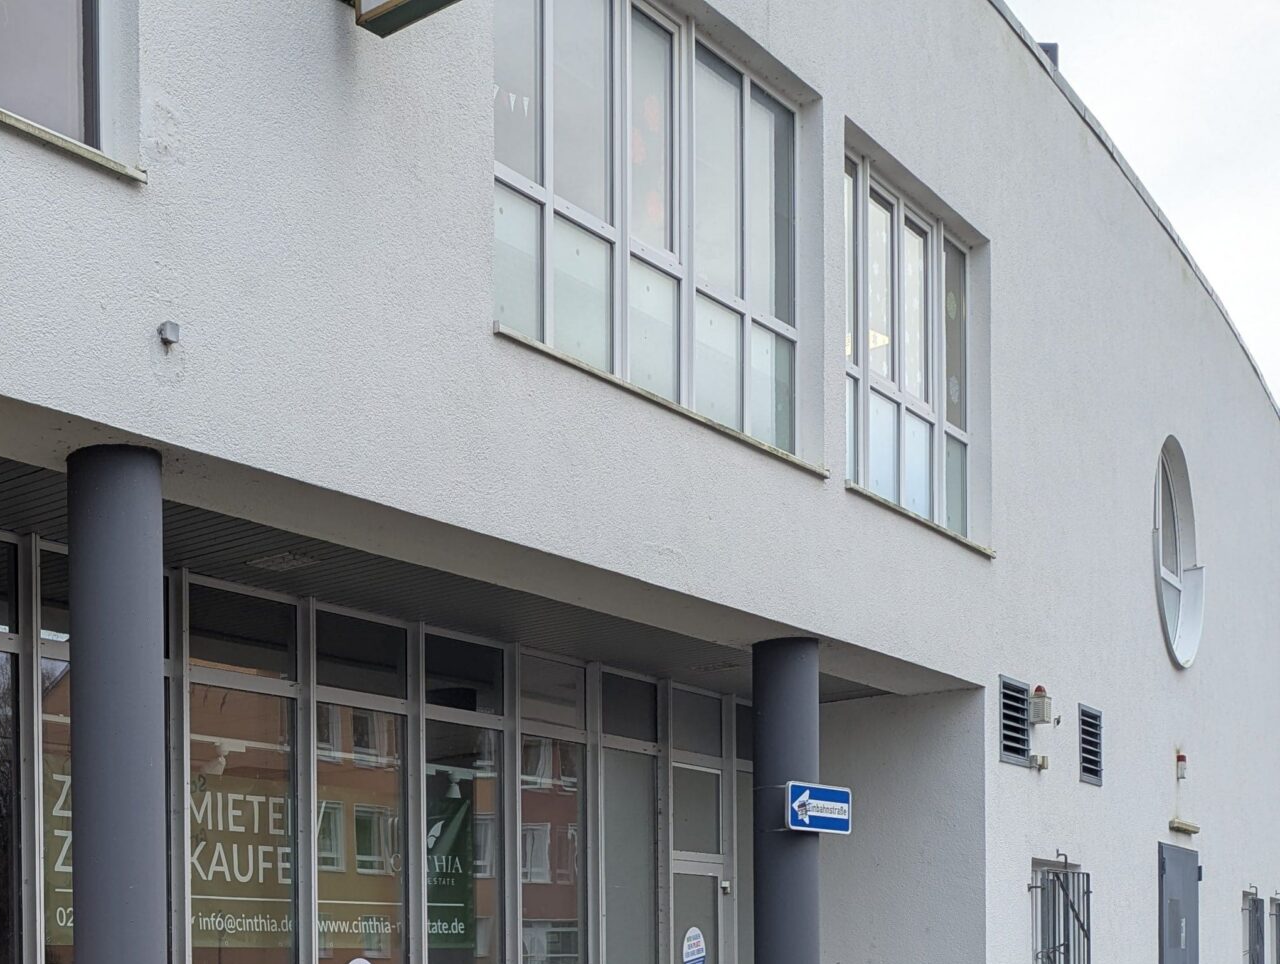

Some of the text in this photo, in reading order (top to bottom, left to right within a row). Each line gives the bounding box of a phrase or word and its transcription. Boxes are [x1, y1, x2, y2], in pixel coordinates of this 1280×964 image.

[52, 773, 72, 818] Z
[190, 791, 292, 836] MIETE
[54, 829, 292, 885] Z KAUFE
[391, 853, 463, 874] CTHIA
